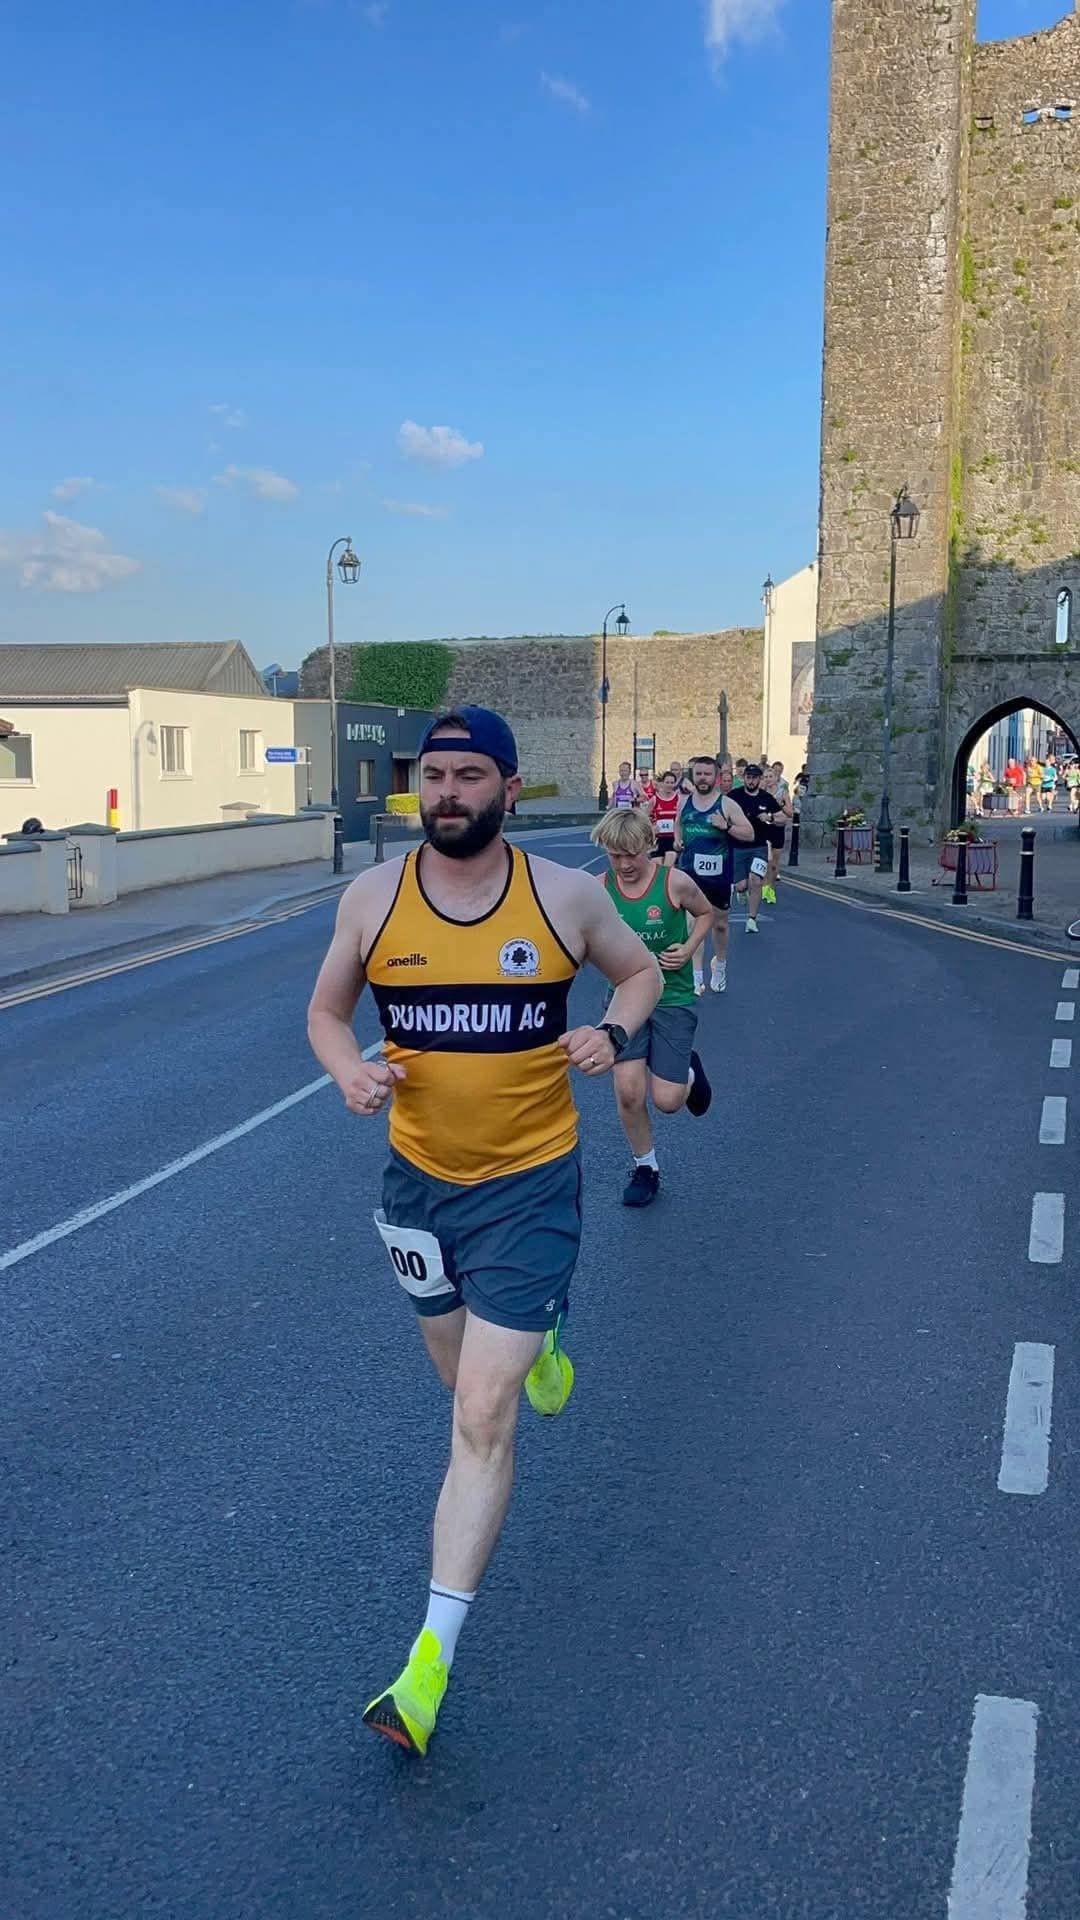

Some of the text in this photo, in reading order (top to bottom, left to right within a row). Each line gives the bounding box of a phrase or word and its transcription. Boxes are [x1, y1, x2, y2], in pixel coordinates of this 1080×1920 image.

[698, 860, 717, 871] 201
[635, 930, 653, 941] OCK
[388, 1001, 547, 1033] DUNDRUM AC
